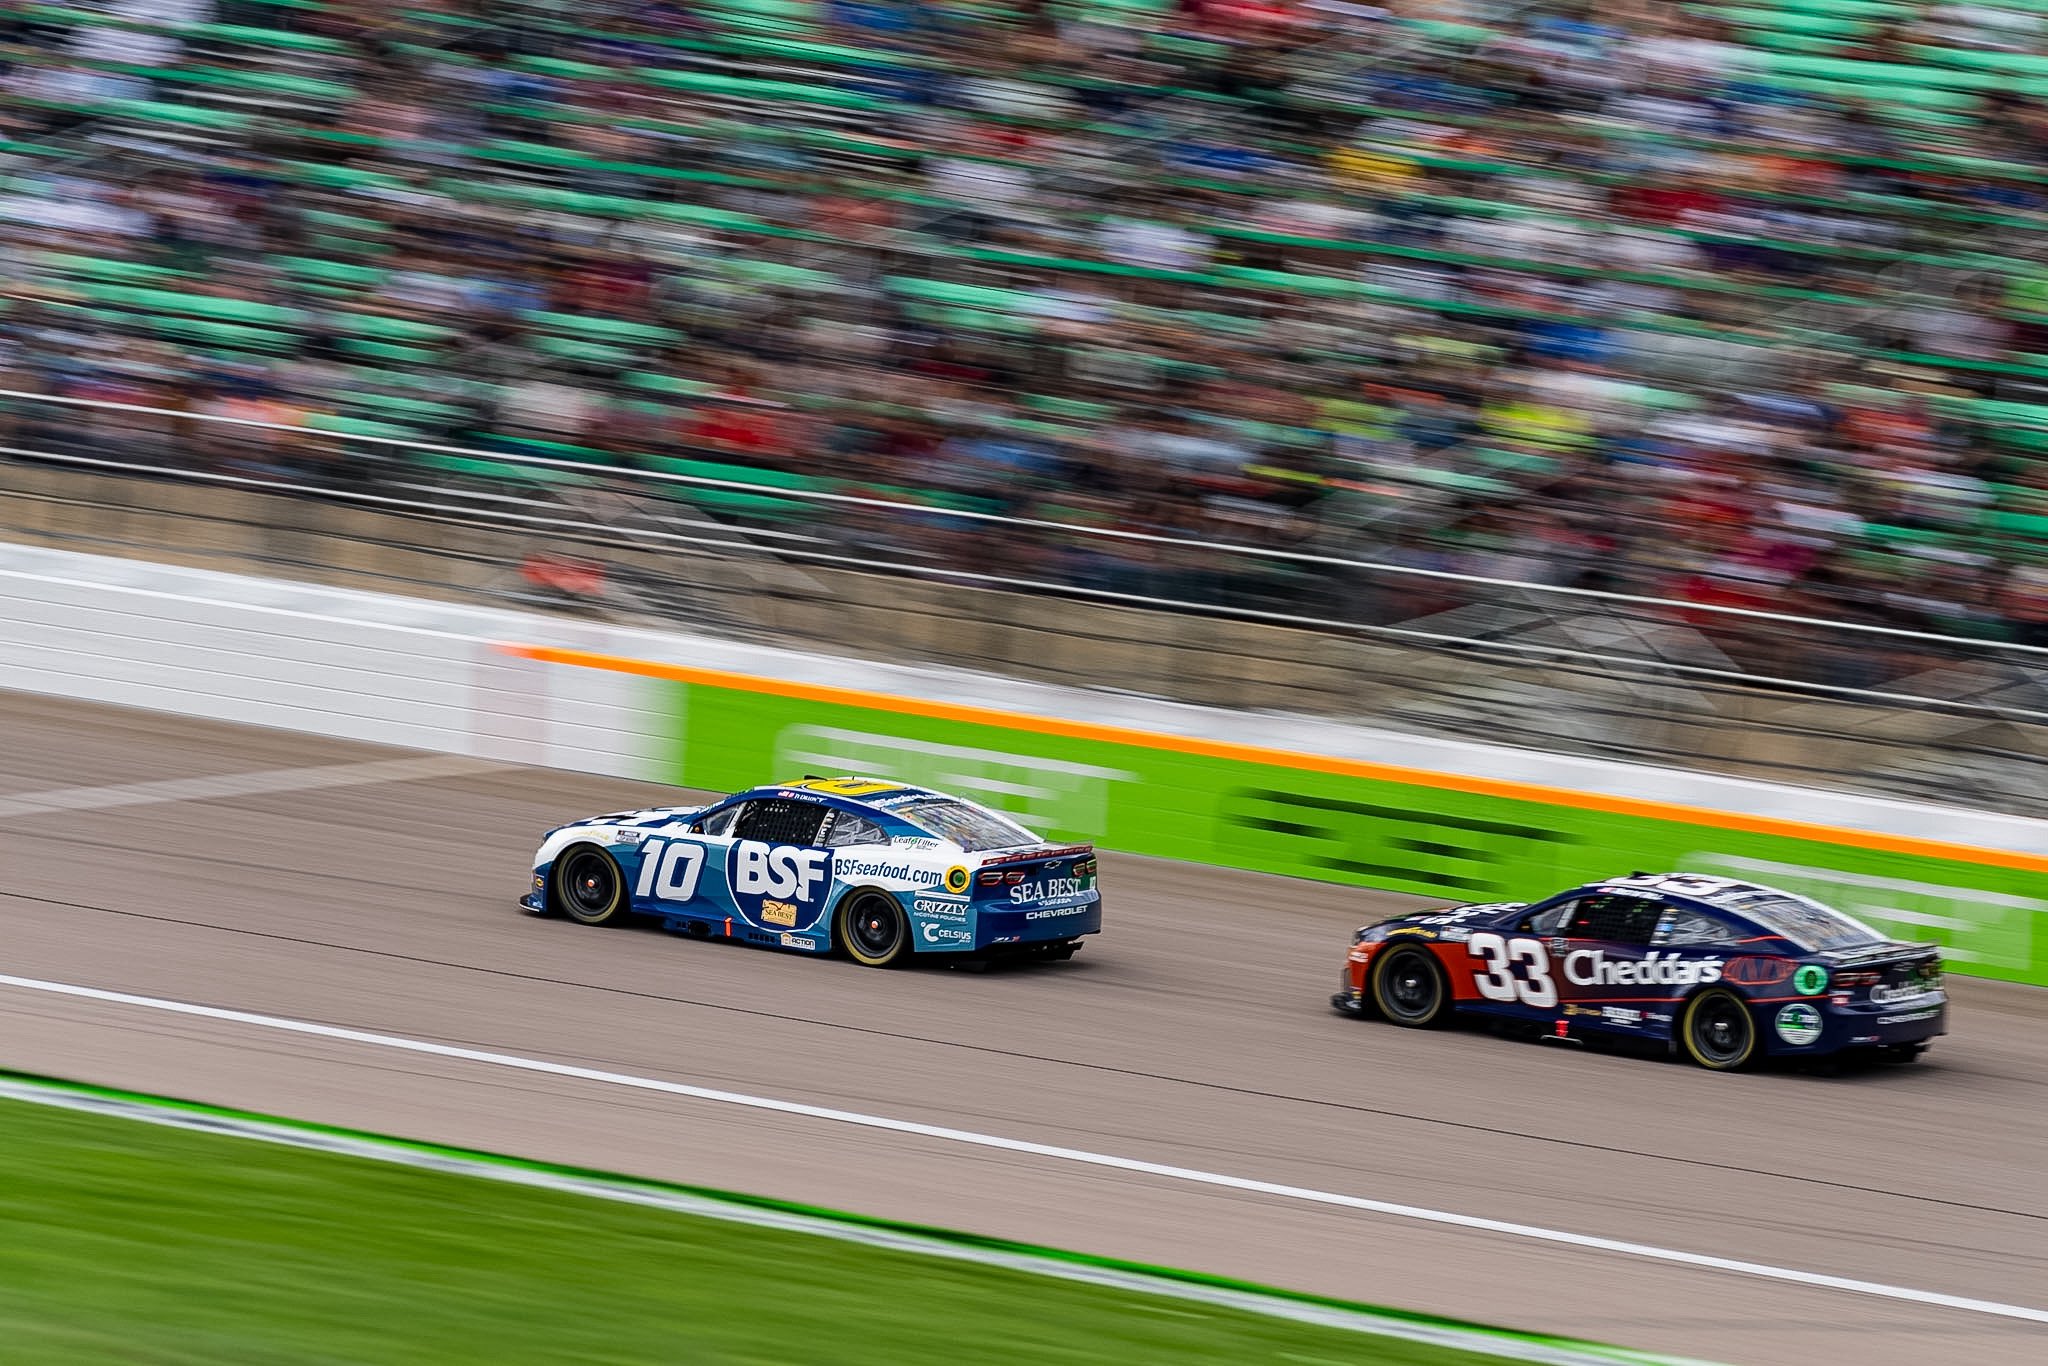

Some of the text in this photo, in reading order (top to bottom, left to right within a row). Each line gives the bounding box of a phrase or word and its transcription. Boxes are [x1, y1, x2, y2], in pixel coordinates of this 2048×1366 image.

[636, 838, 705, 902] 10
[736, 839, 830, 903] BSF
[834, 857, 943, 887] BSFseafood.com
[1009, 877, 1083, 905] SEA BEST
[913, 899, 969, 916] GRIZZLY
[1025, 905, 1088, 920] CHEVROLET
[938, 929, 972, 941] CELSIUS
[1469, 932, 1558, 1008] 33
